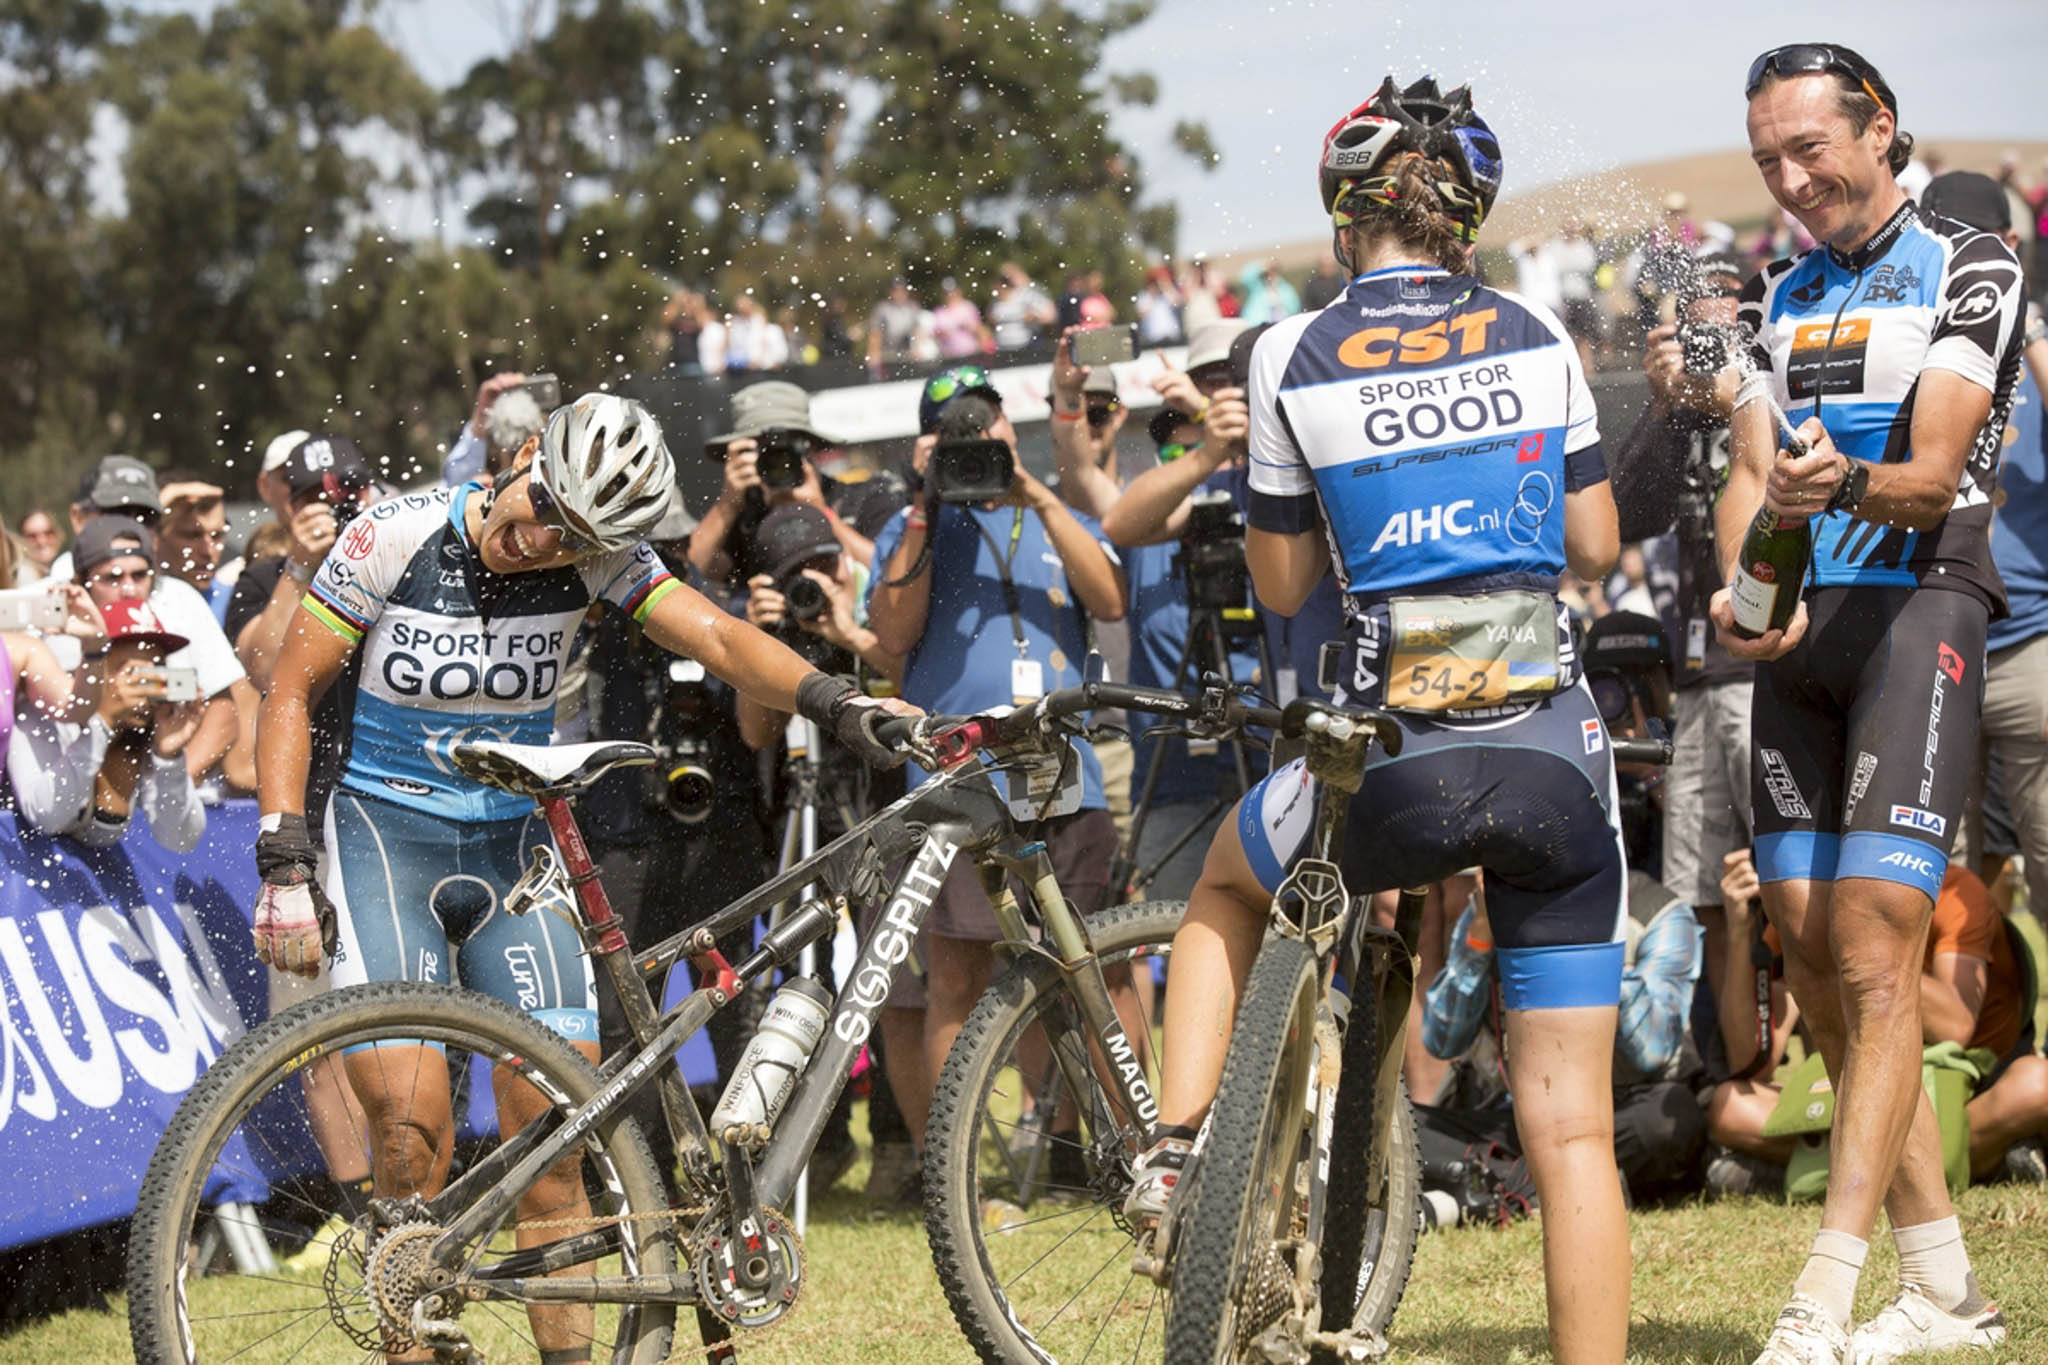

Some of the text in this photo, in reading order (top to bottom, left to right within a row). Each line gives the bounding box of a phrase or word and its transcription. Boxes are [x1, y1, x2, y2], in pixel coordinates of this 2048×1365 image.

[1336, 151, 1371, 165] BBB
[1337, 307, 1498, 369] CST
[1359, 364, 1513, 406] SPORT FOR
[1364, 388, 1524, 447] GOOD
[1352, 437, 1518, 479] SUPERIOR
[1369, 499, 1500, 553] AHC.nl
[391, 622, 564, 658] SPORT FOR
[1353, 613, 1379, 691] FILA
[1485, 624, 1538, 644] YANA
[382, 651, 559, 701] GOOD
[1409, 665, 1488, 702] 54-2
[1919, 669, 1947, 808] SUPERIOR
[1896, 808, 1942, 833] FILA
[504, 942, 541, 1010] tune
